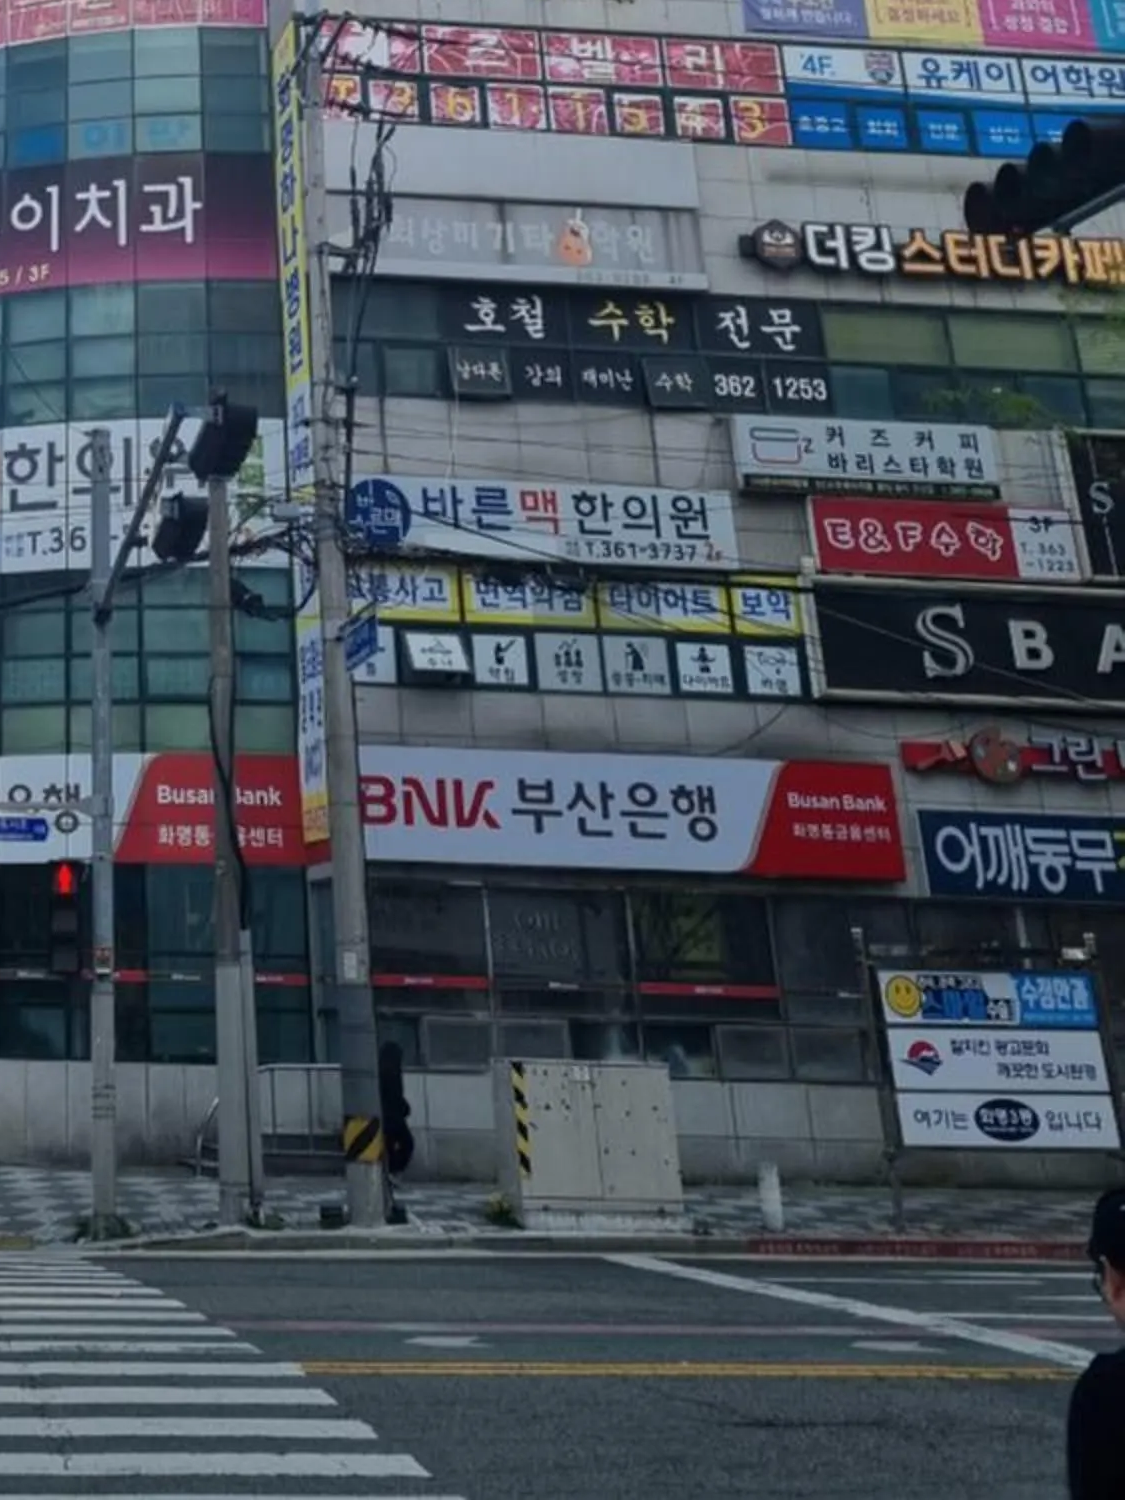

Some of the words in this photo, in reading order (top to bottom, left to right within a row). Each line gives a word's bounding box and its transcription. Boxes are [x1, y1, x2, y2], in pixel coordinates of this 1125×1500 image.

[463, 294, 546, 340] 호철
[587, 300, 675, 345] 수학
[715, 304, 802, 352] 전문
[714, 373, 756, 398] 362
[772, 377, 828, 401] 1253
[826, 453, 985, 480] 바리스타학원
[421, 484, 711, 541] 바른맥한의원
[741, 591, 793, 621] 보약
[1029, 723, 1125, 780] 그린
[359, 774, 501, 831] BNK
[511, 777, 720, 844] 부산은행
[787, 791, 841, 810] Busan
[842, 793, 887, 813] Bank
[934, 821, 1117, 894] 어깨동무
[912, 1107, 970, 1130] 여기는
[1045, 1109, 1103, 1133] 입니다
